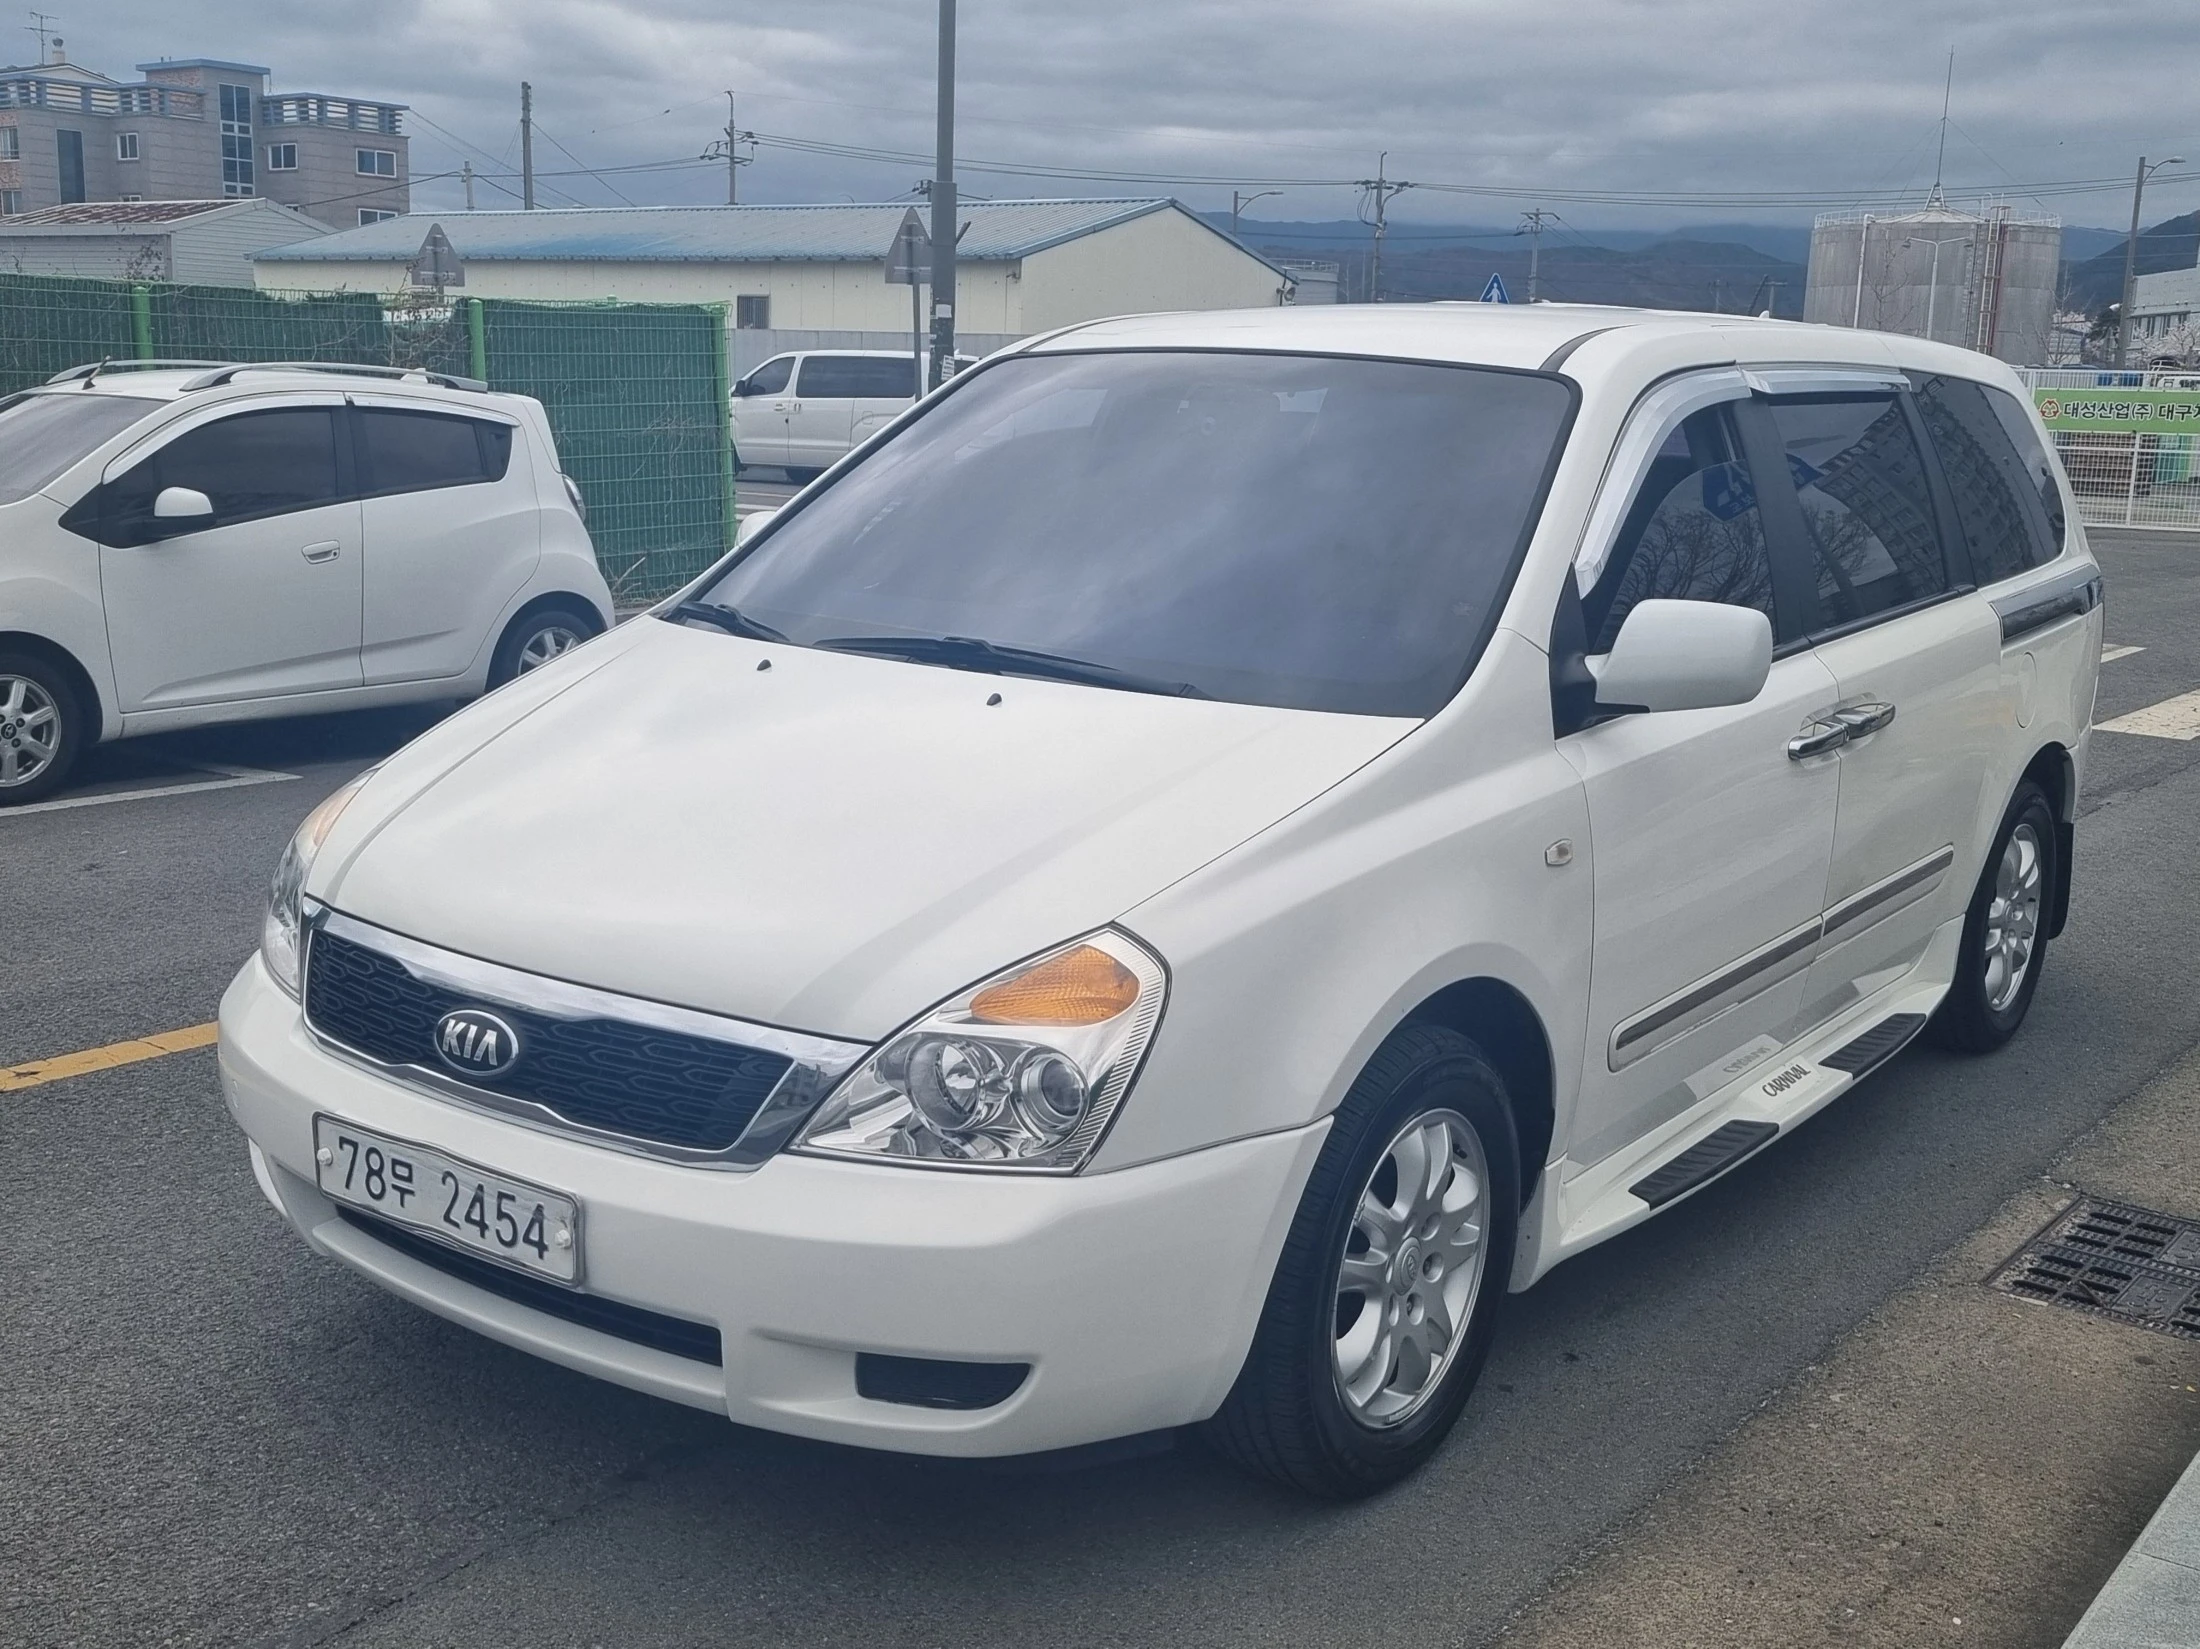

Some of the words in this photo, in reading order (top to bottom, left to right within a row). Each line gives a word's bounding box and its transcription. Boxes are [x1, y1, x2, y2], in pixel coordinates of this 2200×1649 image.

[2063, 401, 2154, 420] 대성산업(주)
[442, 1018, 498, 1067] KIA
[1761, 1063, 1812, 1097] CARNIVAL
[338, 1135, 415, 1208] 78무
[441, 1170, 549, 1260] 2454
